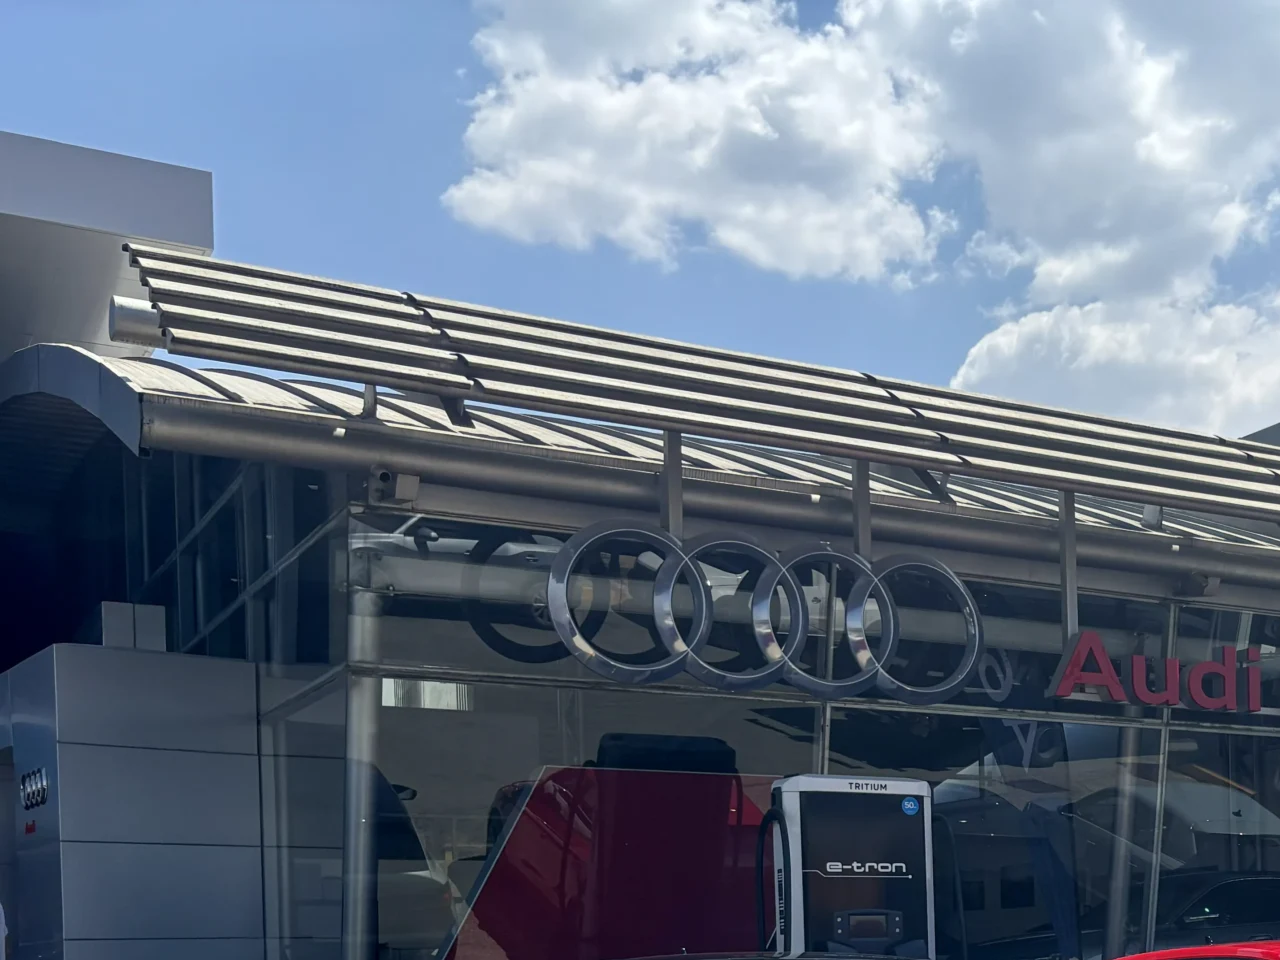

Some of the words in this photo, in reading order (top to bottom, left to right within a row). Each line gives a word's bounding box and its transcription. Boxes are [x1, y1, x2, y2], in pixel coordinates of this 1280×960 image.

[1054, 631, 1262, 713] Audi
[848, 781, 888, 792] TRITIUM
[904, 801, 915, 809] 50
[826, 860, 906, 873] e-tron
